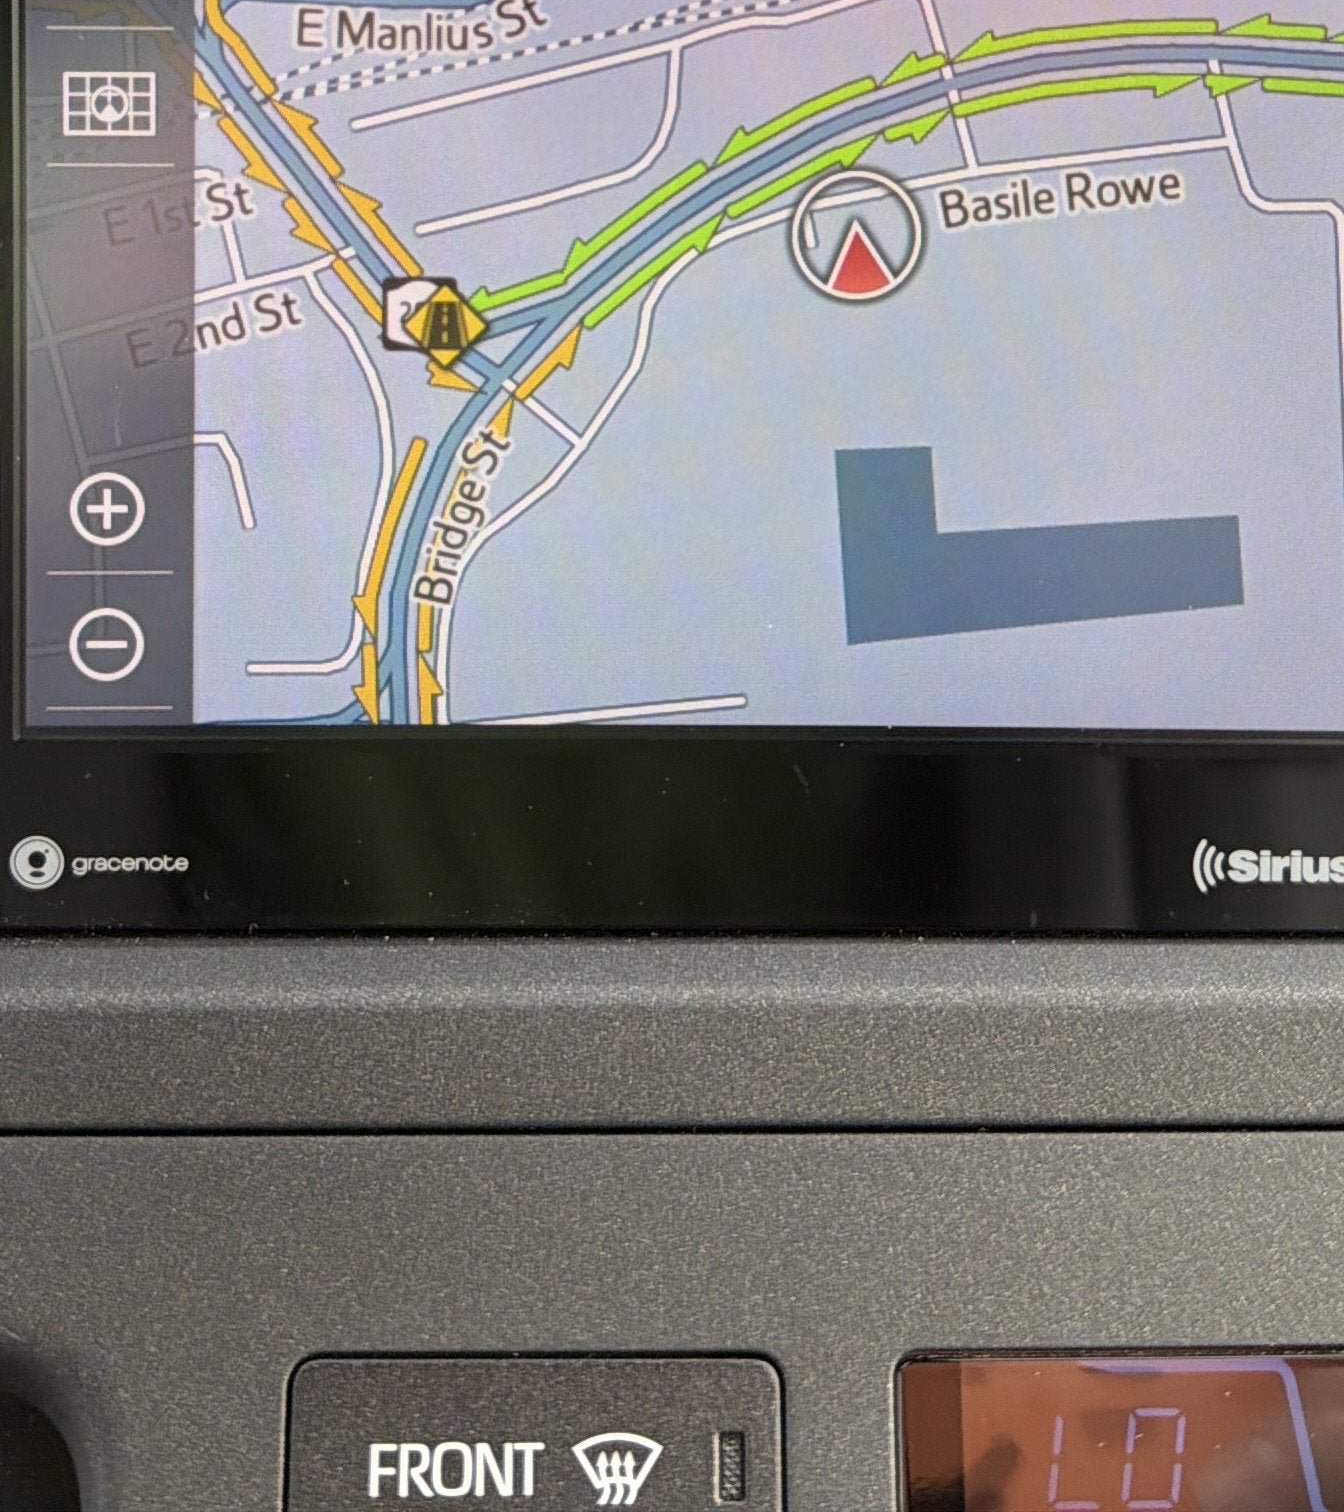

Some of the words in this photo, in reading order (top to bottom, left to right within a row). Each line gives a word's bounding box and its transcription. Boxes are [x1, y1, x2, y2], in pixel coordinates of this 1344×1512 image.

[298, 10, 323, 47] E
[336, 11, 492, 51] Manlius
[104, 210, 134, 246] E
[143, 198, 200, 236] 1st
[207, 186, 253, 223] St
[940, 180, 1057, 230] Basile
[1066, 171, 1182, 214] Rowe
[126, 330, 156, 369] E
[165, 308, 245, 356] 2nd
[258, 294, 302, 331] St
[415, 473, 492, 606] Bridge
[462, 429, 513, 471] St
[72, 855, 189, 876] gracenote
[368, 1441, 545, 1498] FRONT
